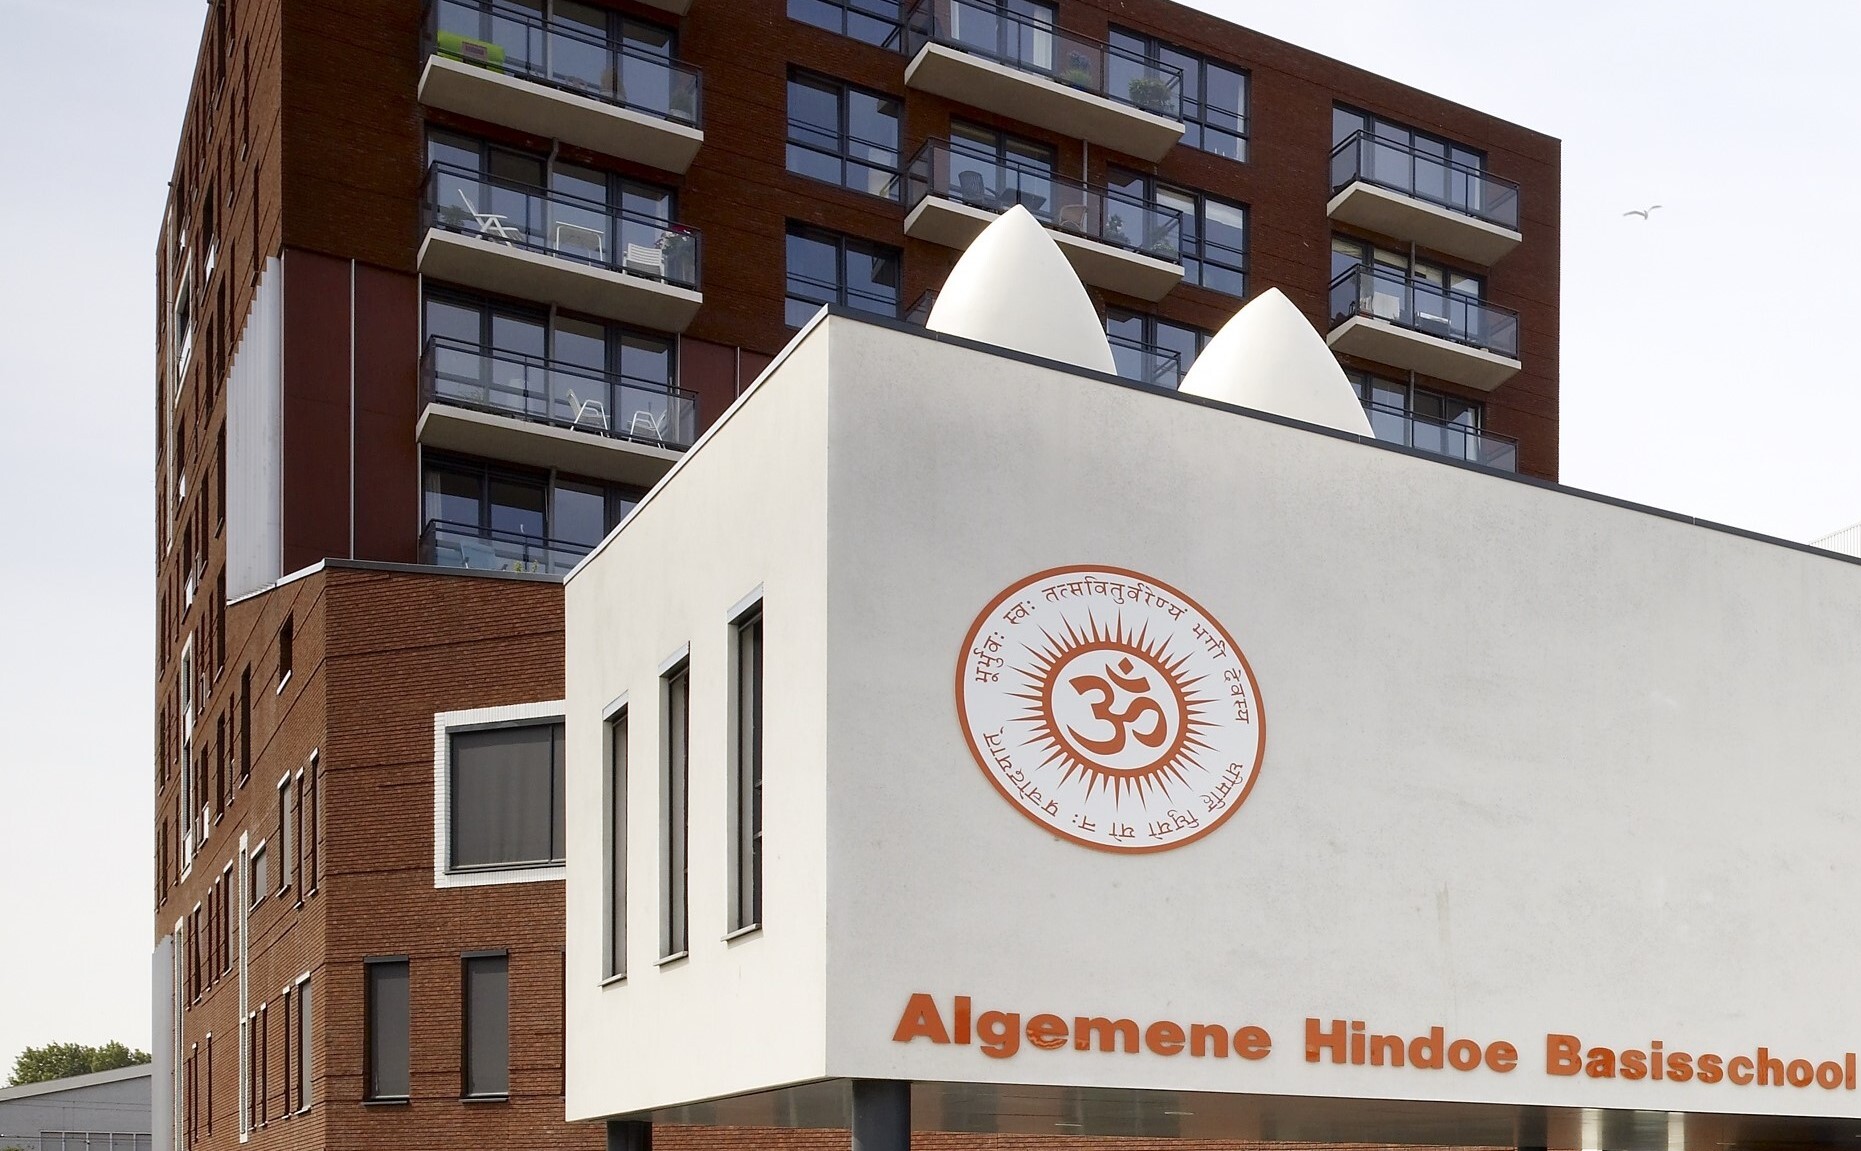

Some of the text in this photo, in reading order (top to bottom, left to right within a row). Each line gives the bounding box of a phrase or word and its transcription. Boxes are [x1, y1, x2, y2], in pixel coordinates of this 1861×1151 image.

[1002, 600, 1036, 625] स्वः
[1223, 668, 1250, 724] देवस्य
[892, 992, 1272, 1059] Algemene
[1304, 1017, 1519, 1073] Hindoe
[1545, 1033, 1857, 1090] Basisschool
